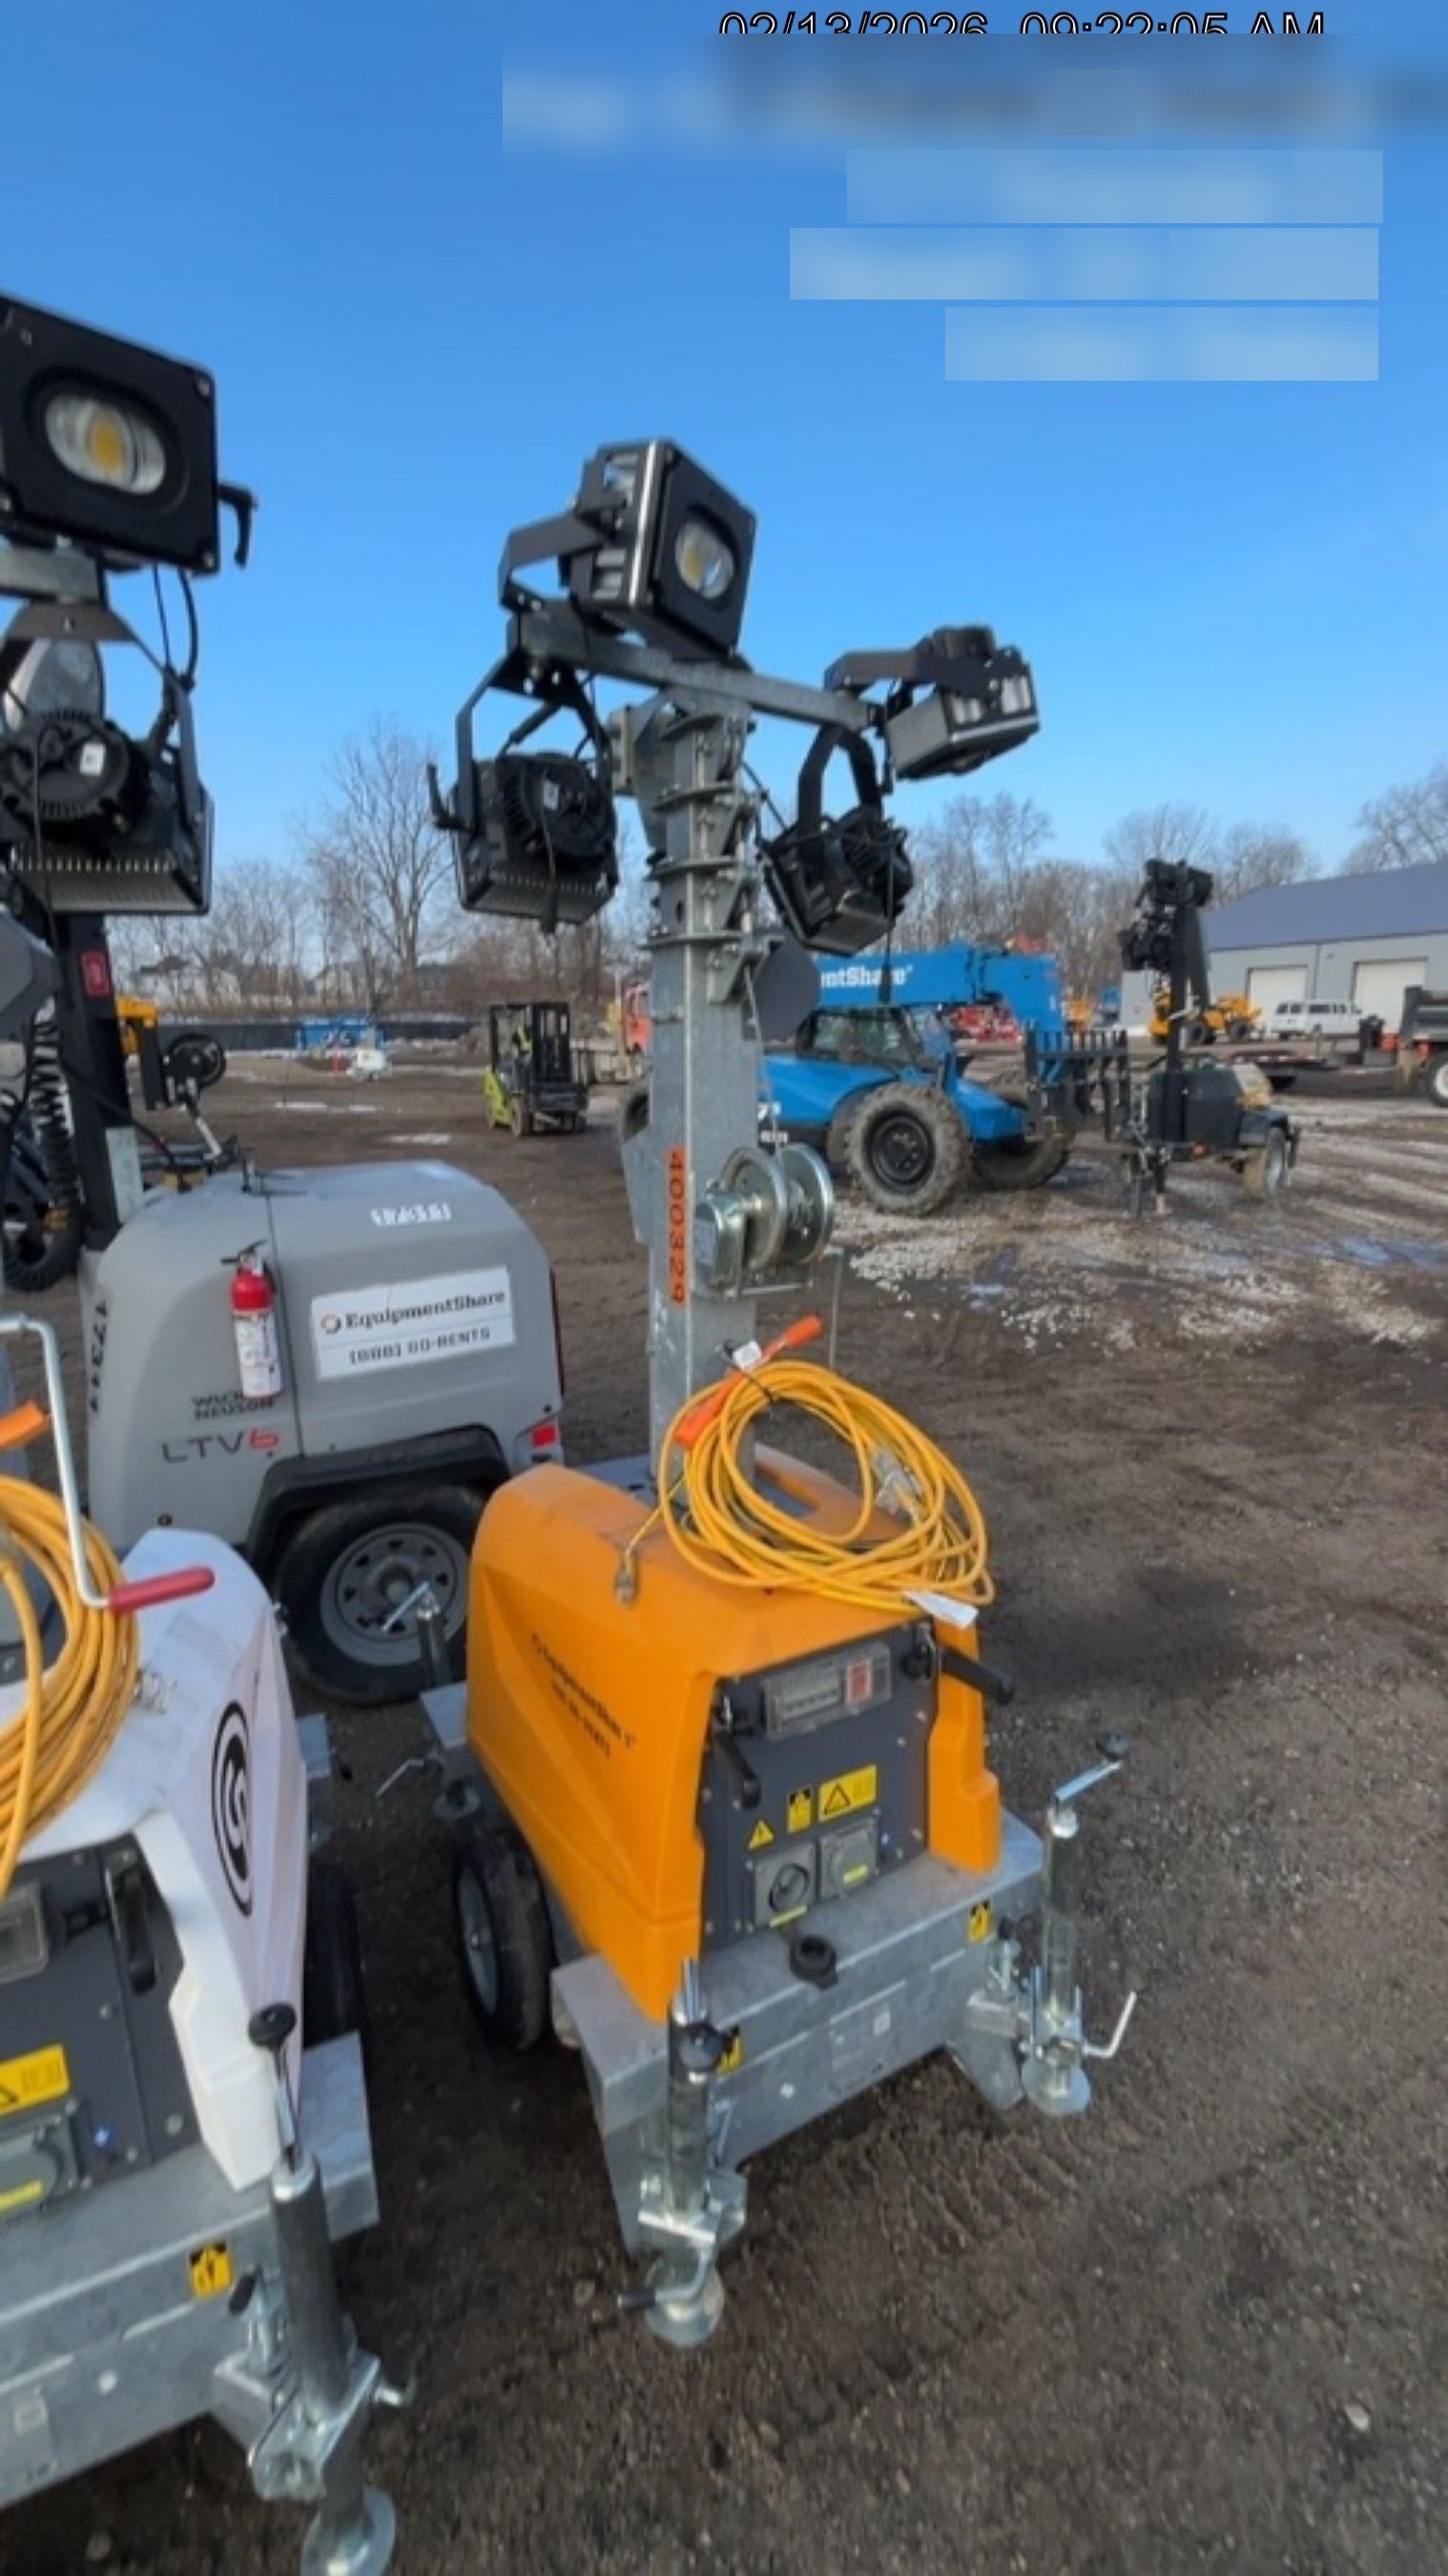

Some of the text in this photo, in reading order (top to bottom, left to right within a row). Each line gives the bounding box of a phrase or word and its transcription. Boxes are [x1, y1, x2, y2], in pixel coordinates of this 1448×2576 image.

[669, 1150, 685, 1304] 400329
[345, 1290, 507, 1332] EquipmentShare
[160, 1427, 279, 1464] LTV6
